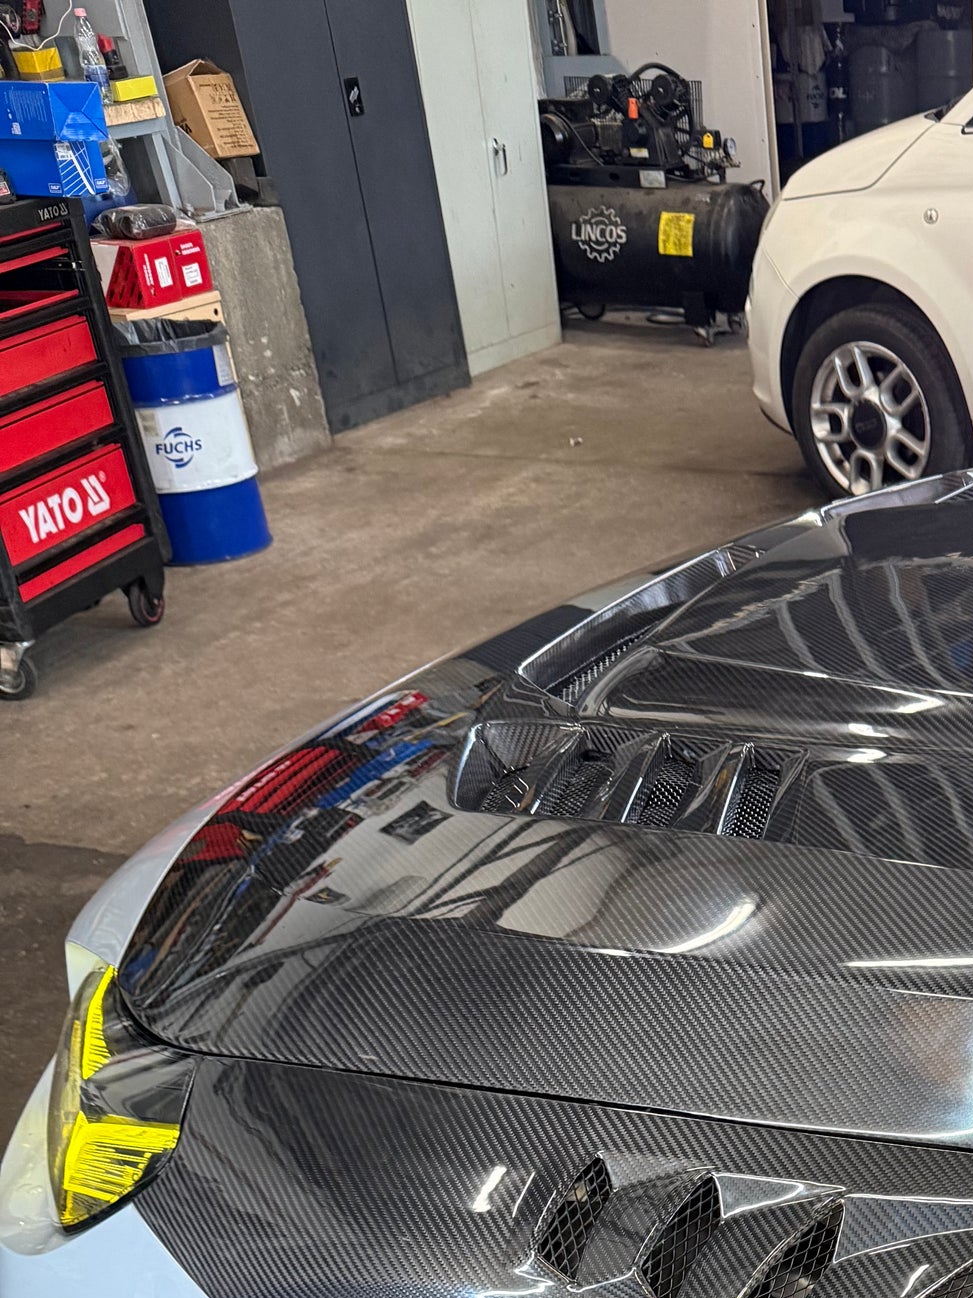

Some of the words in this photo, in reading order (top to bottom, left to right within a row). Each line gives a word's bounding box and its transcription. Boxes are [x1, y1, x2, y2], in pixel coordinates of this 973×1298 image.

[38, 206, 59, 221] YATO
[571, 223, 627, 243] LINCOS
[155, 439, 202, 455] FUCHS
[18, 487, 84, 544] YATO
